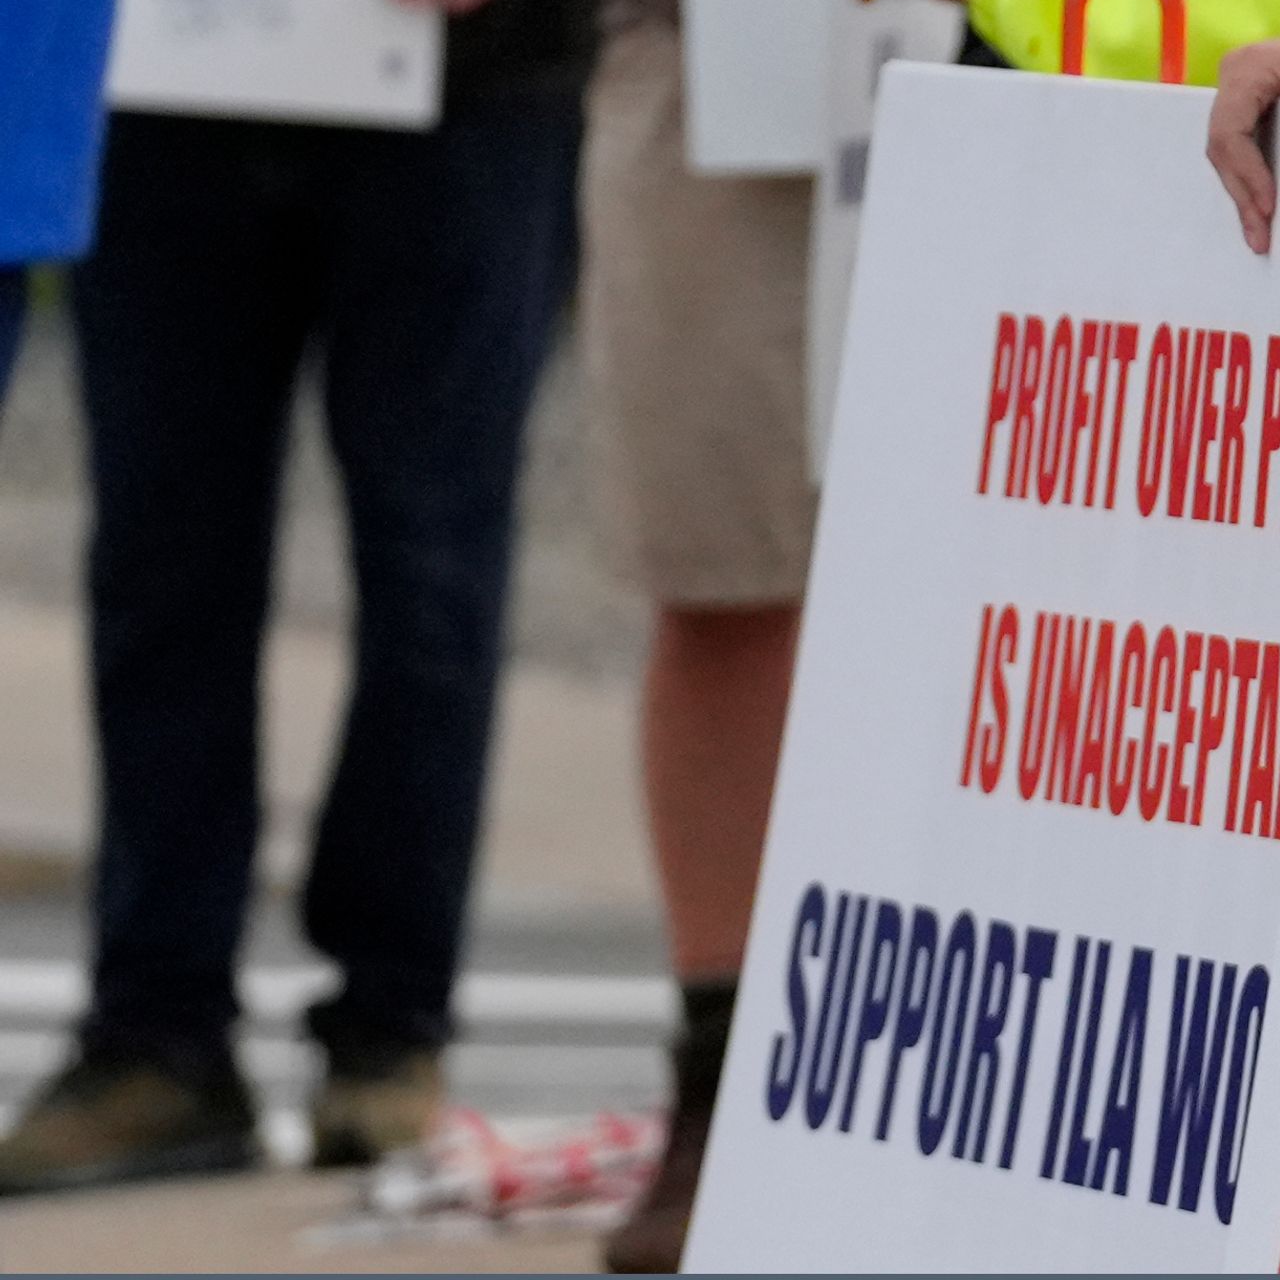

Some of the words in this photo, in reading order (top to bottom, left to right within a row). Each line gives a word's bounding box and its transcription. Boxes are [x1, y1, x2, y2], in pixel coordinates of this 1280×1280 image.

[979, 314, 1140, 510] PROFIT
[1137, 324, 1252, 525] OVER
[962, 605, 1020, 794] IS
[765, 883, 1059, 1171] SUPPORT
[1039, 936, 1154, 1197] ILA
[1148, 954, 1271, 1226] WO
